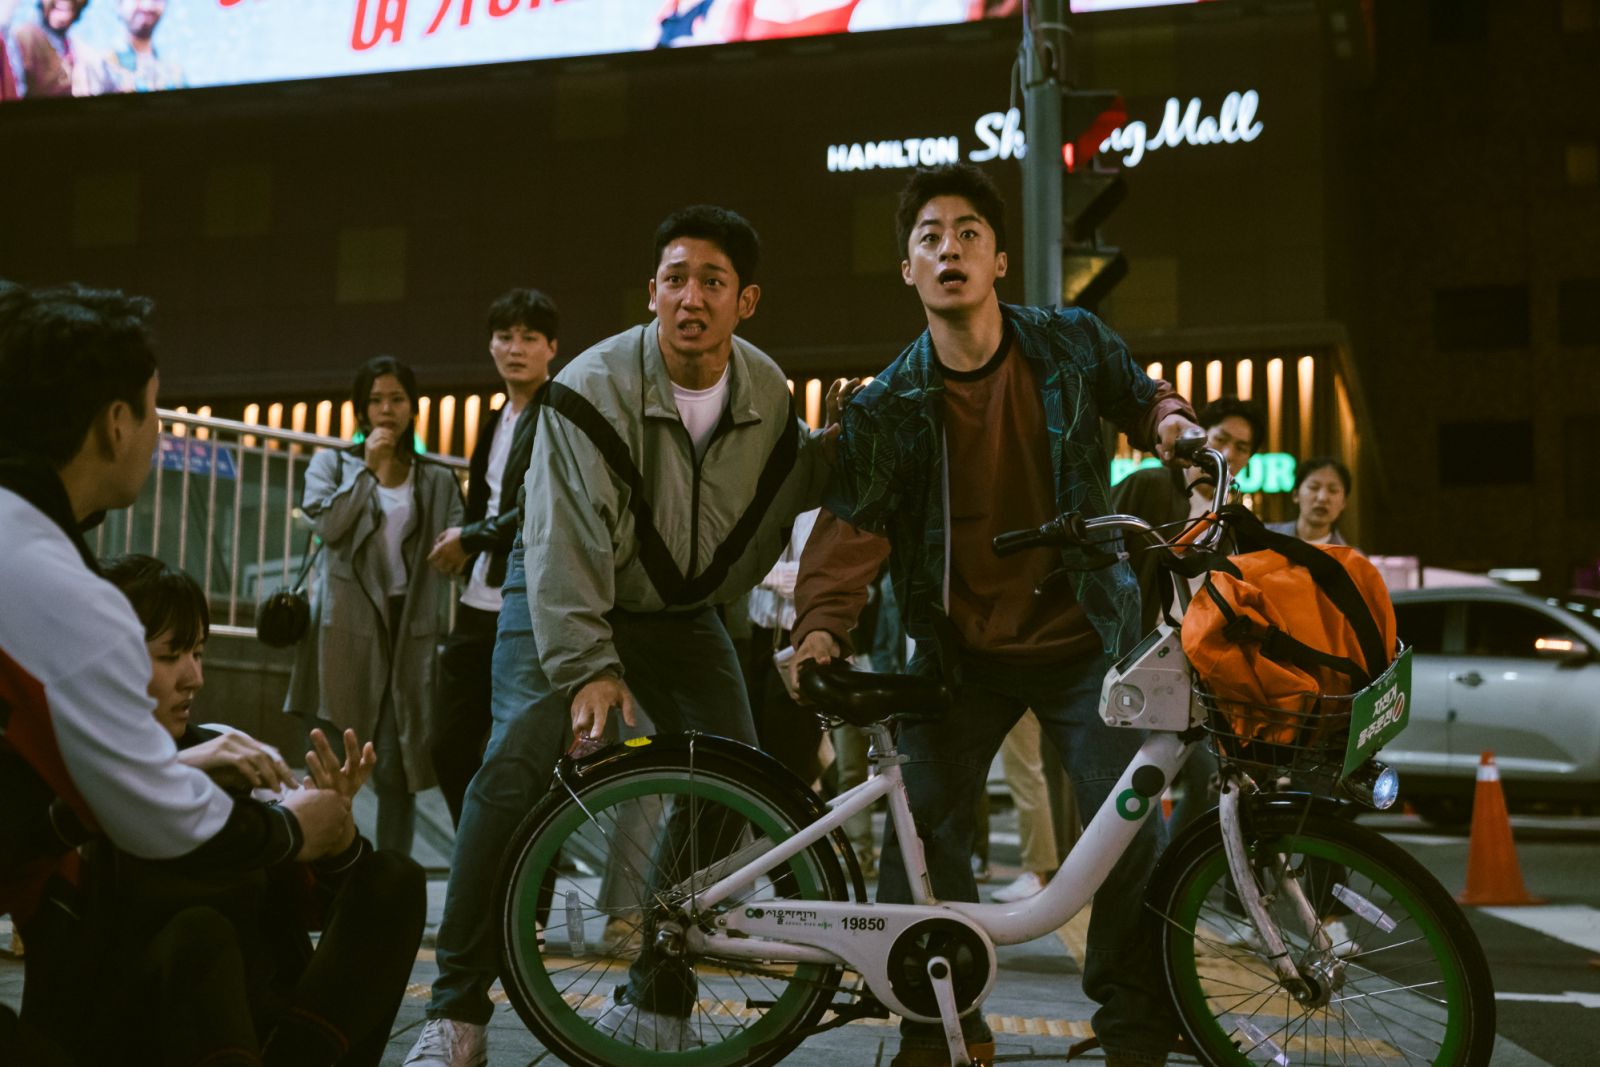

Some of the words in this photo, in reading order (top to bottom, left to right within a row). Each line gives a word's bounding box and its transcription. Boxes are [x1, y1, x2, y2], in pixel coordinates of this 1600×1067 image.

[827, 136, 959, 172] HAMILTON
[1145, 89, 1265, 151] Mall
[1372, 683, 1397, 718] 자전거
[841, 916, 886, 931] 19850
